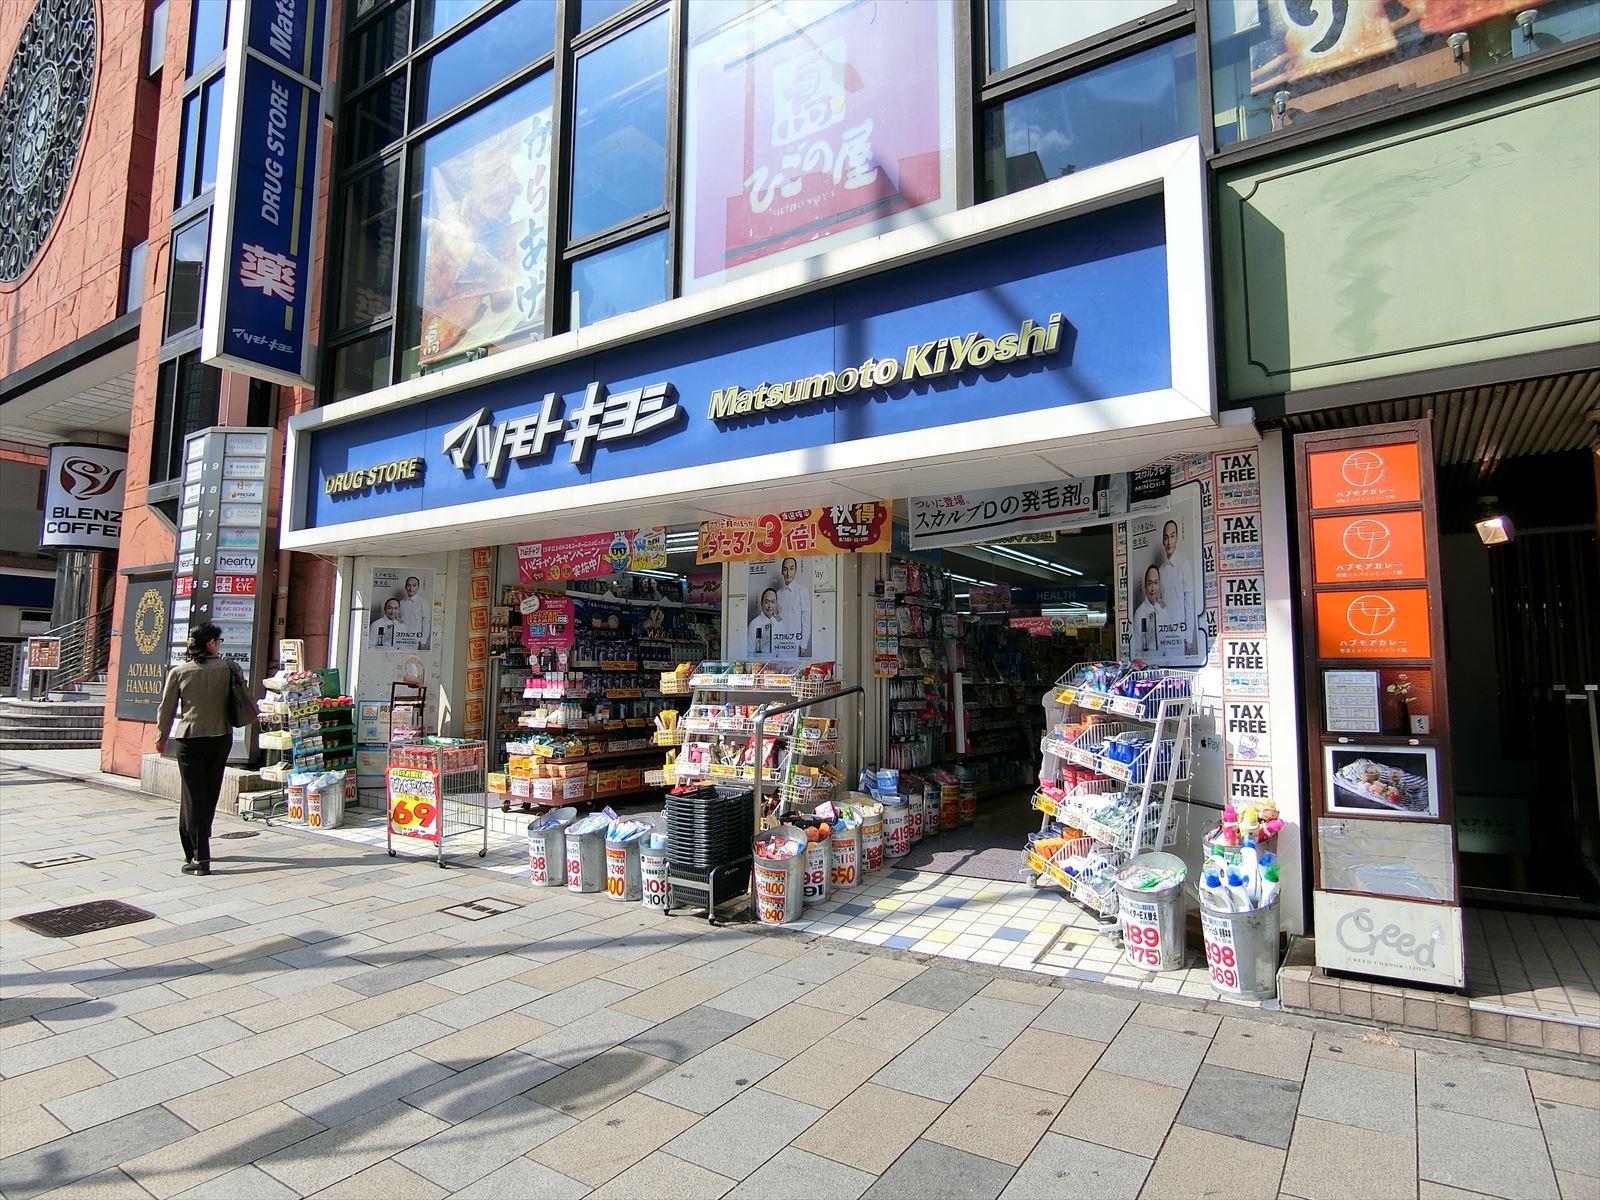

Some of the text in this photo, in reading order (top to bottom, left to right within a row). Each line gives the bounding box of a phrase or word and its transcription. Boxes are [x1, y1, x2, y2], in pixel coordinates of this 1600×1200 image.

[261, 79, 289, 226] DRUG STORE
[742, 118, 879, 214] ひごの屋
[239, 241, 298, 303] 薬
[232, 326, 295, 354] マツモトキヨシ
[707, 311, 1065, 421] Matsumoto KiYoshi
[442, 380, 682, 480] マツモトキヨシ
[212, 462, 219, 471] 9
[1220, 453, 1253, 470] TAX
[324, 456, 421, 496] DRUG STORE
[1220, 467, 1256, 483] FREE
[209, 486, 217, 494] 8
[914, 494, 971, 509] ついに登場。
[914, 482, 1090, 531] スカルプDの発毛剤。
[52, 506, 122, 523] BLENZ
[208, 509, 215, 518] 7
[829, 503, 876, 525] 秋得
[46, 521, 121, 538] COFFE
[836, 524, 869, 537] セール
[1223, 515, 1256, 531] TAX
[206, 532, 213, 541] 7
[1222, 529, 1259, 545] FREE
[203, 556, 212, 565] 6
[219, 556, 256, 569] hearty
[202, 580, 210, 588] 5
[1226, 578, 1258, 593] TAX
[1036, 590, 1076, 600] HEALTH
[1225, 591, 1262, 607] FREE
[199, 604, 208, 613] 4
[1228, 641, 1260, 656] TAX
[127, 663, 162, 677] AOYAMA
[1227, 656, 1264, 669] FREE
[125, 680, 162, 695] HANAMO
[1230, 704, 1264, 719] TAX
[1229, 719, 1267, 734] FREE
[1207, 738, 1220, 752] Pay
[1233, 768, 1266, 784] TAX
[1231, 783, 1269, 799] FREE
[392, 799, 437, 828] 69
[765, 881, 785, 895] 400
[764, 908, 784, 921] 690
[1126, 921, 1160, 948] 189
[1335, 907, 1436, 969] Creed
[1204, 938, 1236, 968] 398
